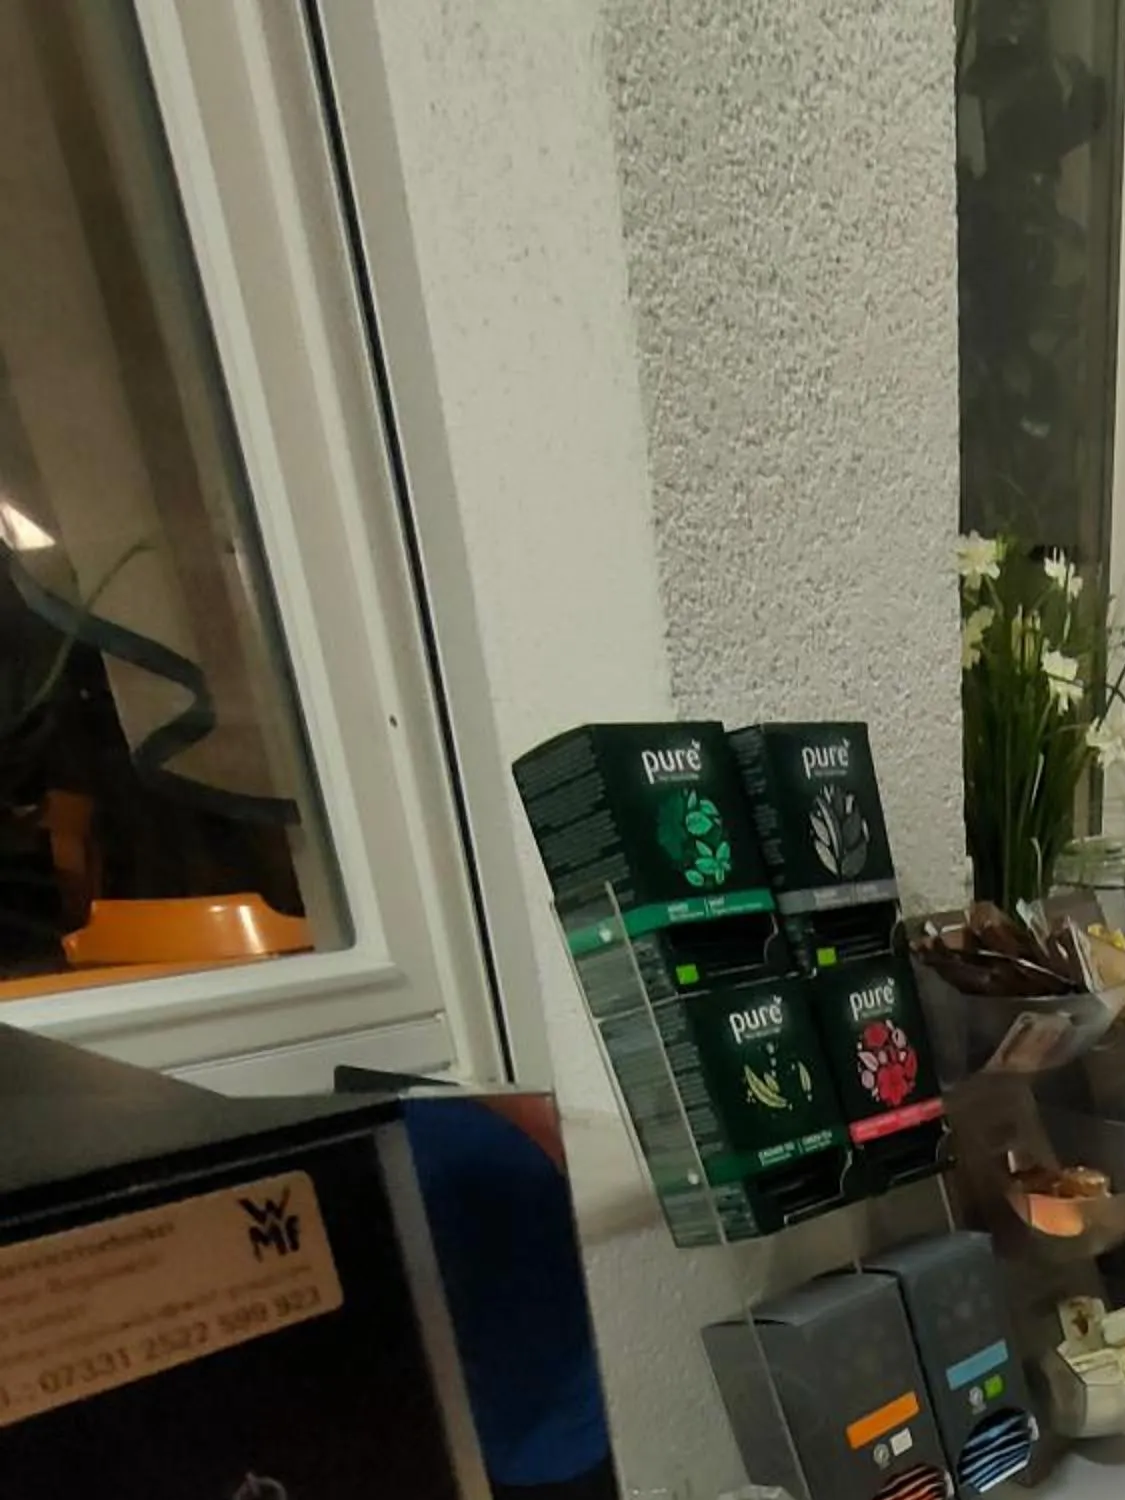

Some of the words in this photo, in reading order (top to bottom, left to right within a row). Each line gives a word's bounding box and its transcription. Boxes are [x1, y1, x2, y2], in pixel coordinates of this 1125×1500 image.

[641, 743, 702, 784] pure
[801, 743, 850, 779] pure
[849, 981, 895, 1021] pure
[729, 999, 783, 1044] pure
